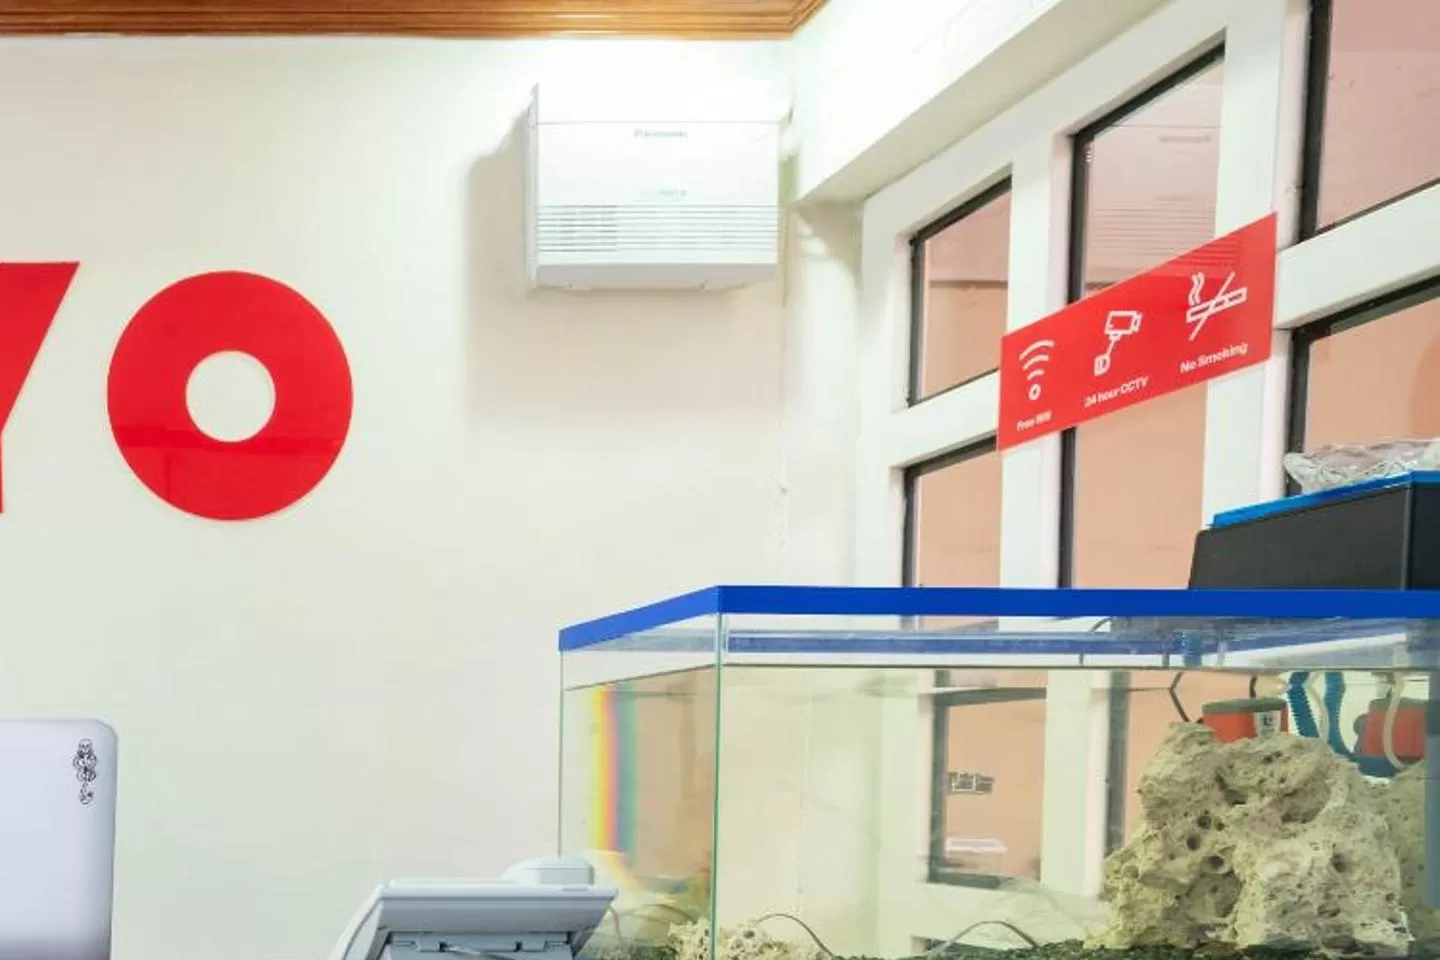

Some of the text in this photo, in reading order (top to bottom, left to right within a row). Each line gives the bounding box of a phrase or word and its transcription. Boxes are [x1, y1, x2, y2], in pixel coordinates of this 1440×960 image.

[1180, 342, 1248, 374] No Smoking
[1120, 376, 1149, 394] CCTV
